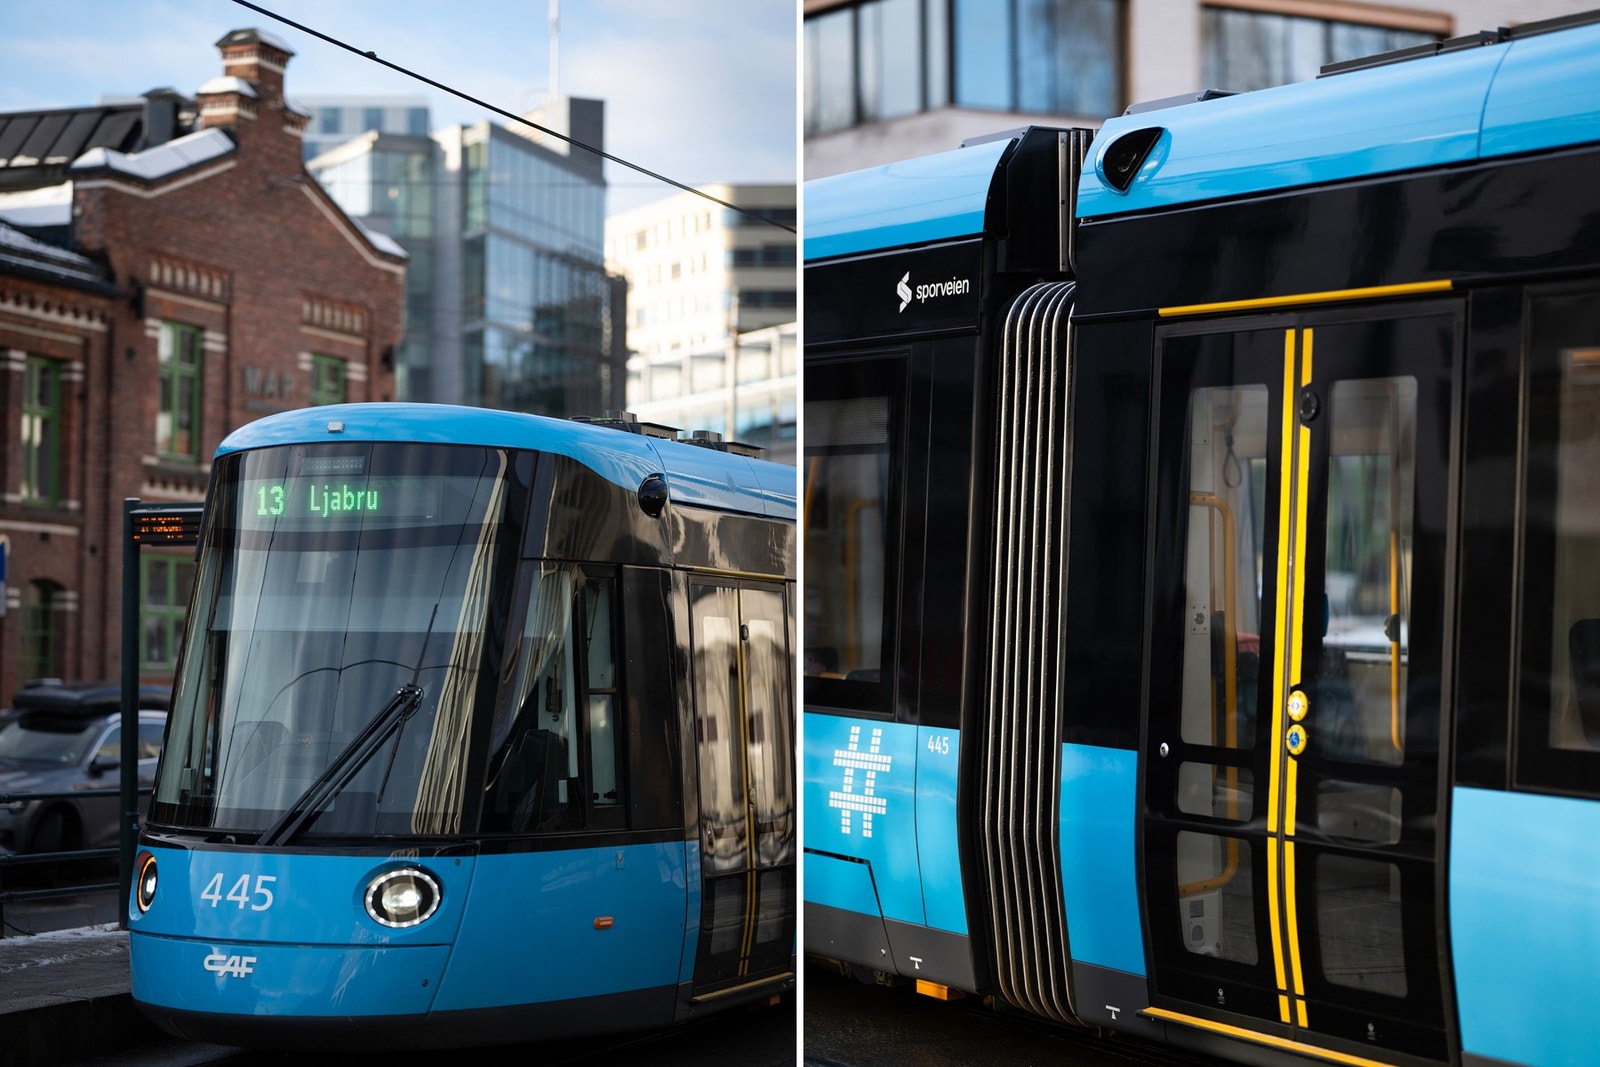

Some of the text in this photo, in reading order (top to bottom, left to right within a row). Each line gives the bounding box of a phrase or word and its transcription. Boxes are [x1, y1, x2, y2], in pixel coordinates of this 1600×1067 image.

[915, 276, 970, 304] sporveien
[256, 484, 379, 518] 13 Ljabru
[927, 735, 949, 755] 445
[200, 872, 277, 912] 445
[203, 953, 258, 979] CAF
